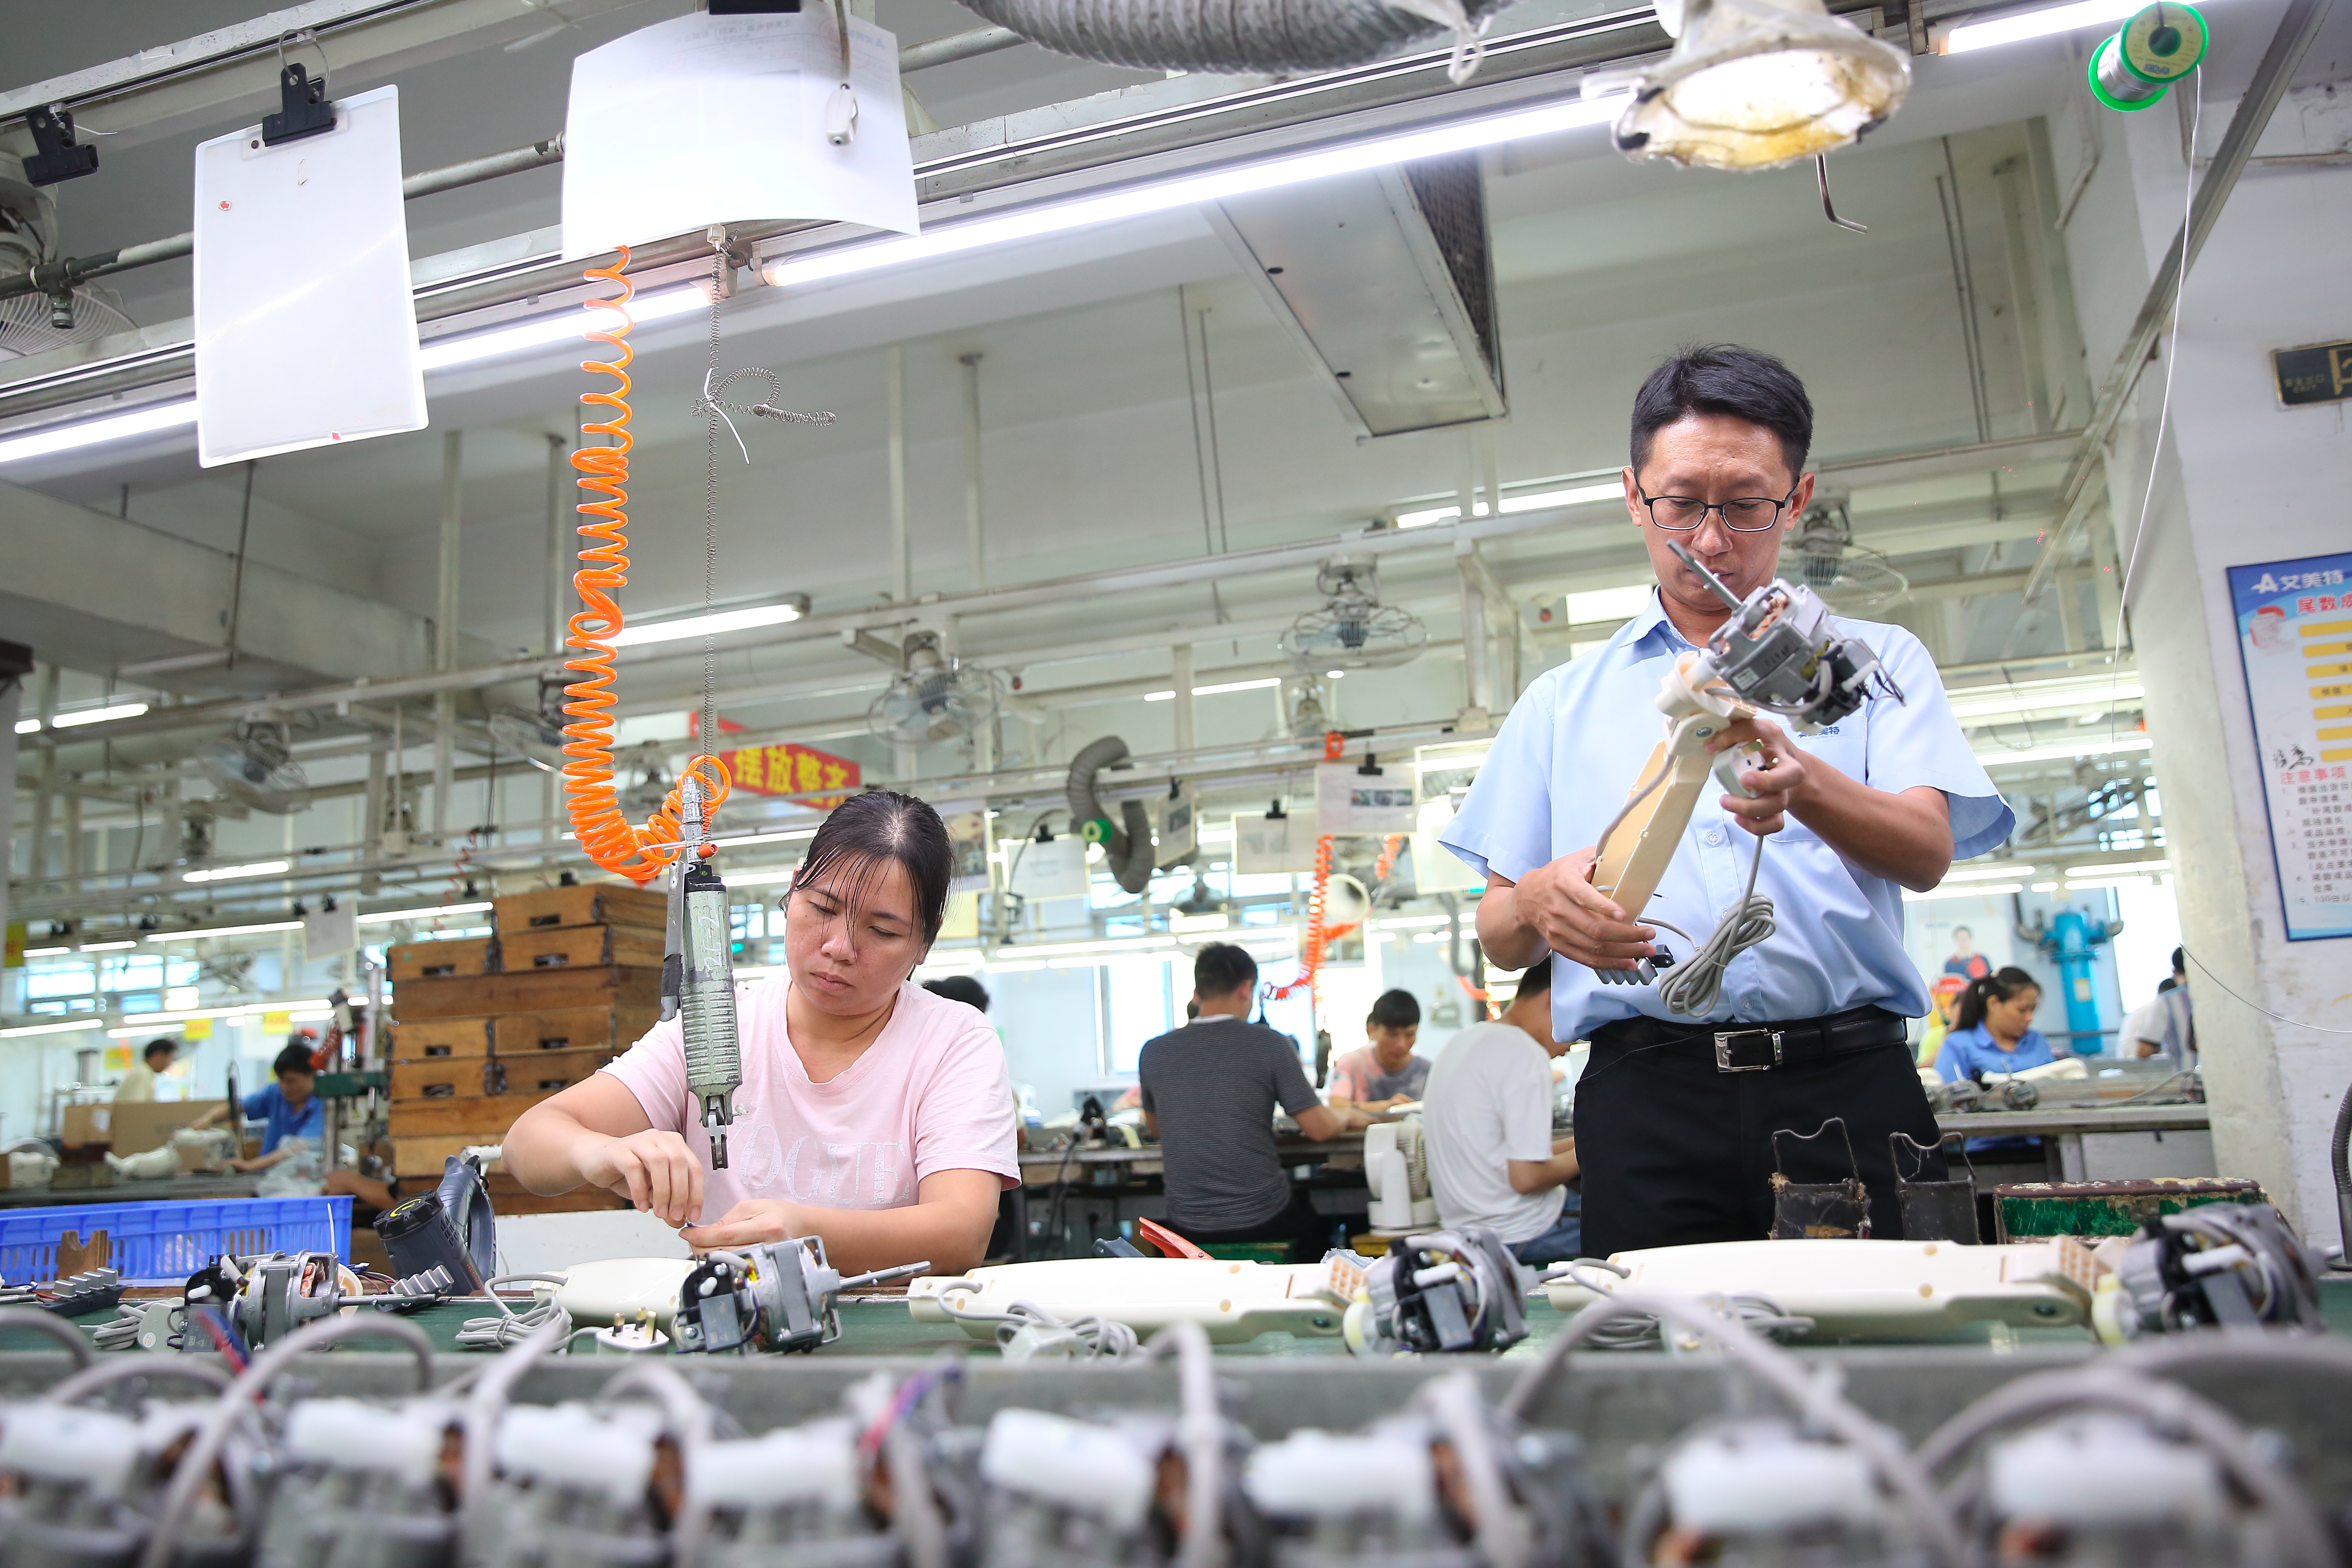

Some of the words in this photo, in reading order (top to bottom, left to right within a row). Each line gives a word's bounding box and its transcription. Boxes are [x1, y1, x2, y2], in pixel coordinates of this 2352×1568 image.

[2278, 568, 2344, 592] 艾美特
[2280, 766, 2345, 785] 注意事项
